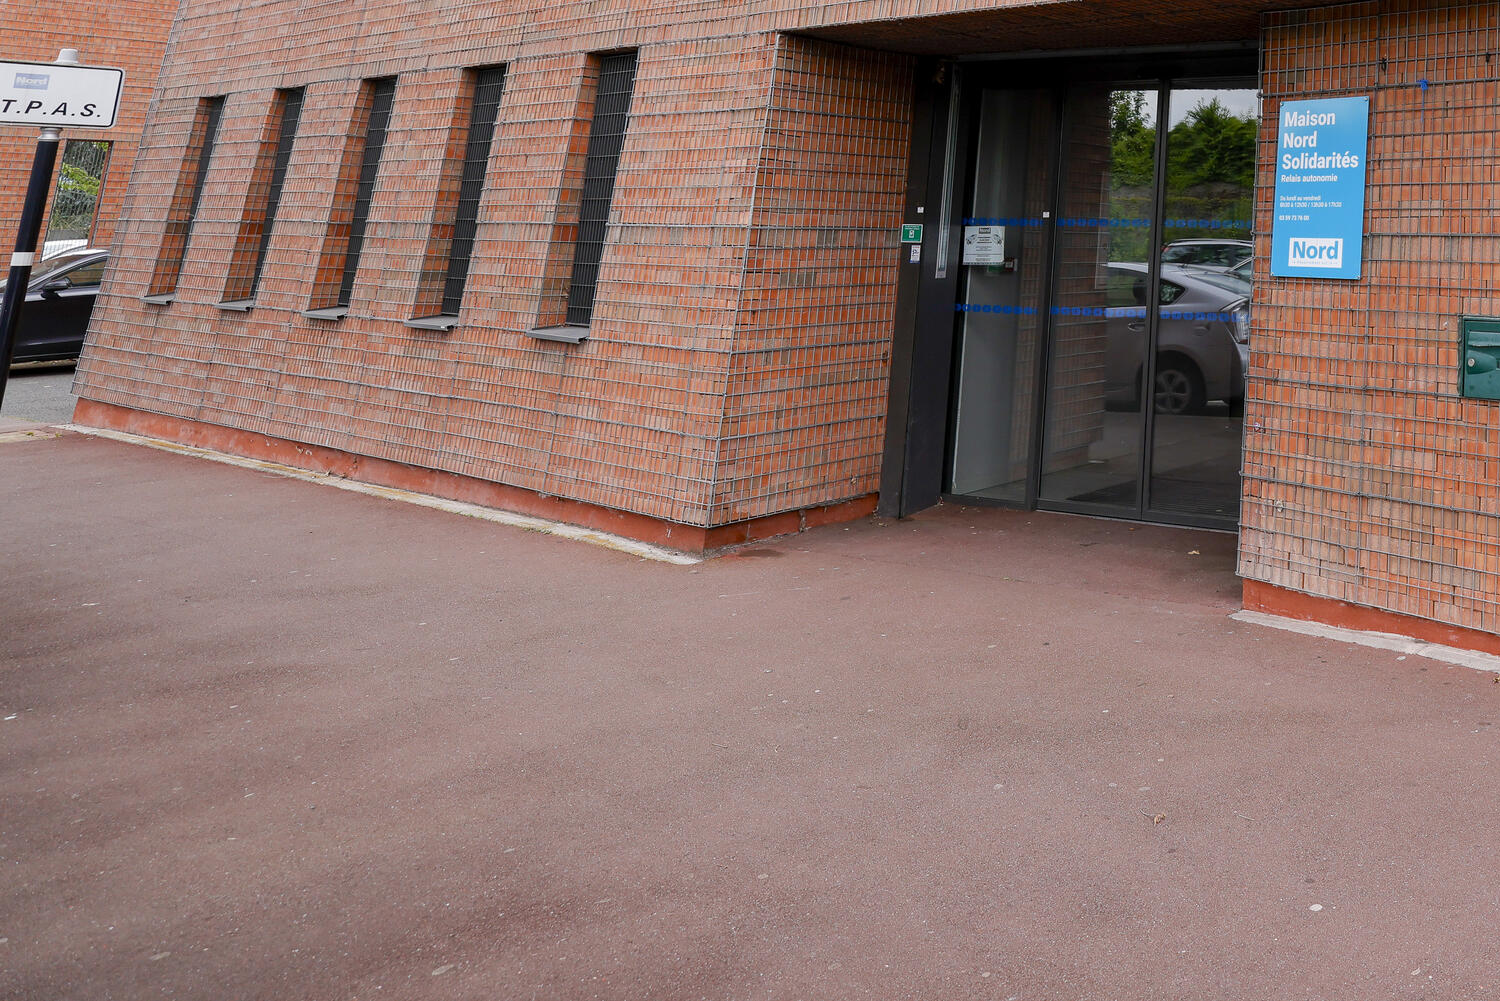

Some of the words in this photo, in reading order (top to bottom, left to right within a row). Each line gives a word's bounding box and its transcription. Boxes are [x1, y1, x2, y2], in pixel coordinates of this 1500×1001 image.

[2, 99, 101, 118] T.P.A.S.
[1284, 110, 1336, 127] Maison
[1283, 130, 1318, 149] Nord
[1282, 150, 1359, 170] Solidarités
[1281, 174, 1301, 183] Relais
[1302, 173, 1338, 182] autonomie
[1293, 240, 1339, 260] Nord
